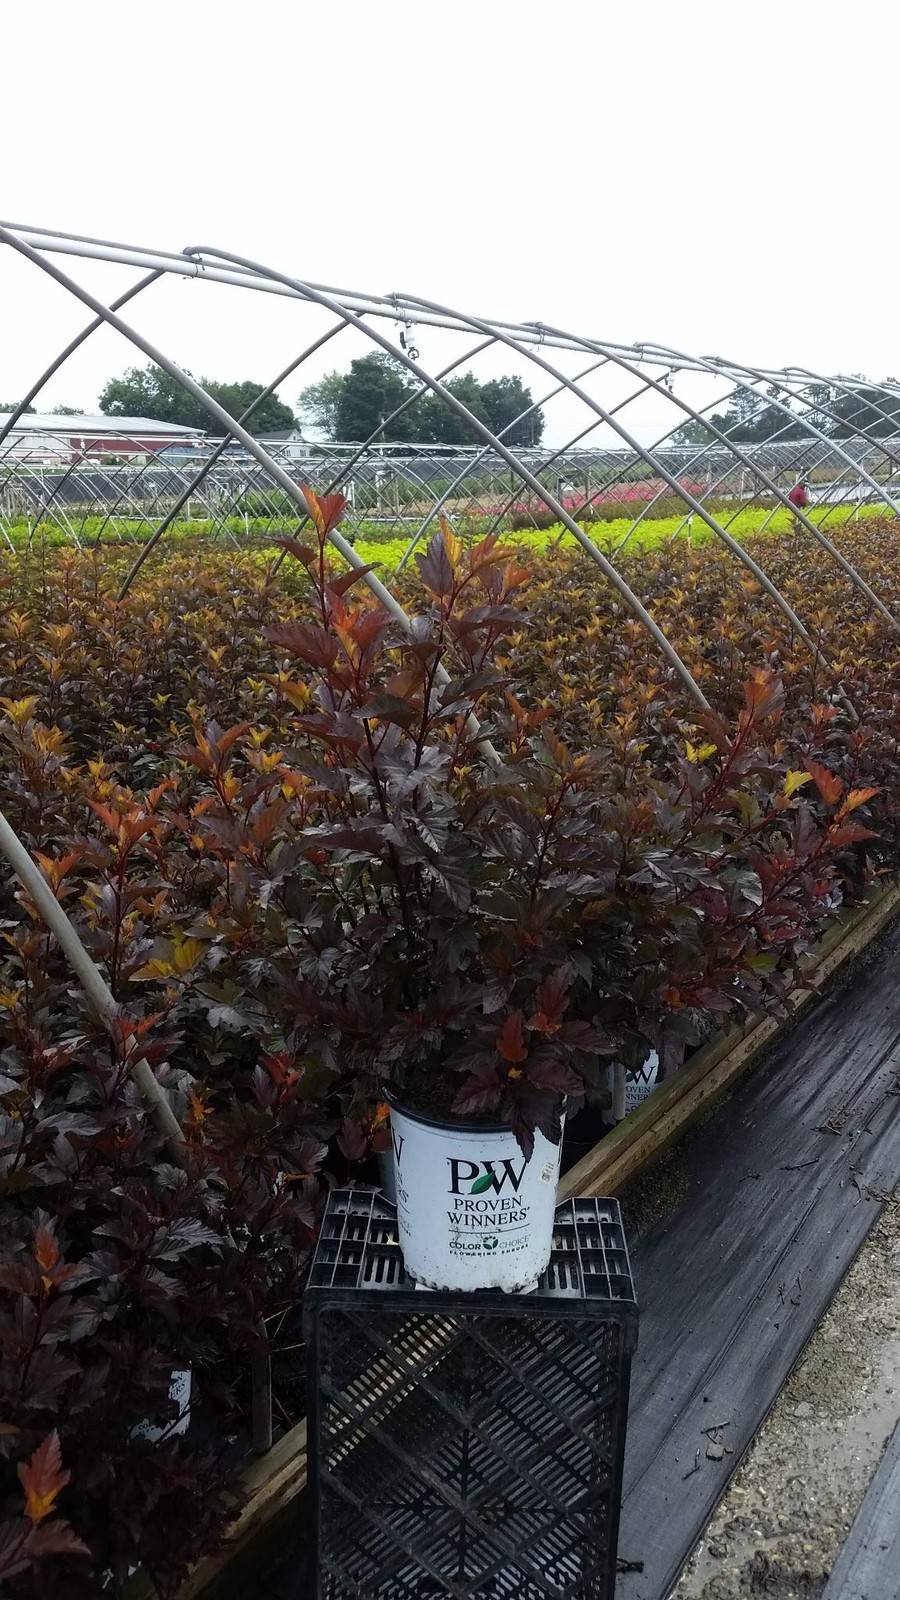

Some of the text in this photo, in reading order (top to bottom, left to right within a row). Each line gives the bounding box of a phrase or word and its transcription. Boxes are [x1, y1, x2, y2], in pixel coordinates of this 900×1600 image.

[633, 1066, 655, 1085] W
[626, 1085, 651, 1093] OVEN
[446, 1157, 529, 1196] PW
[453, 1194, 523, 1213] PROVEN
[449, 1235, 530, 1250] COLOR CHOICE
[501, 1243, 529, 1254] SHRUBS
